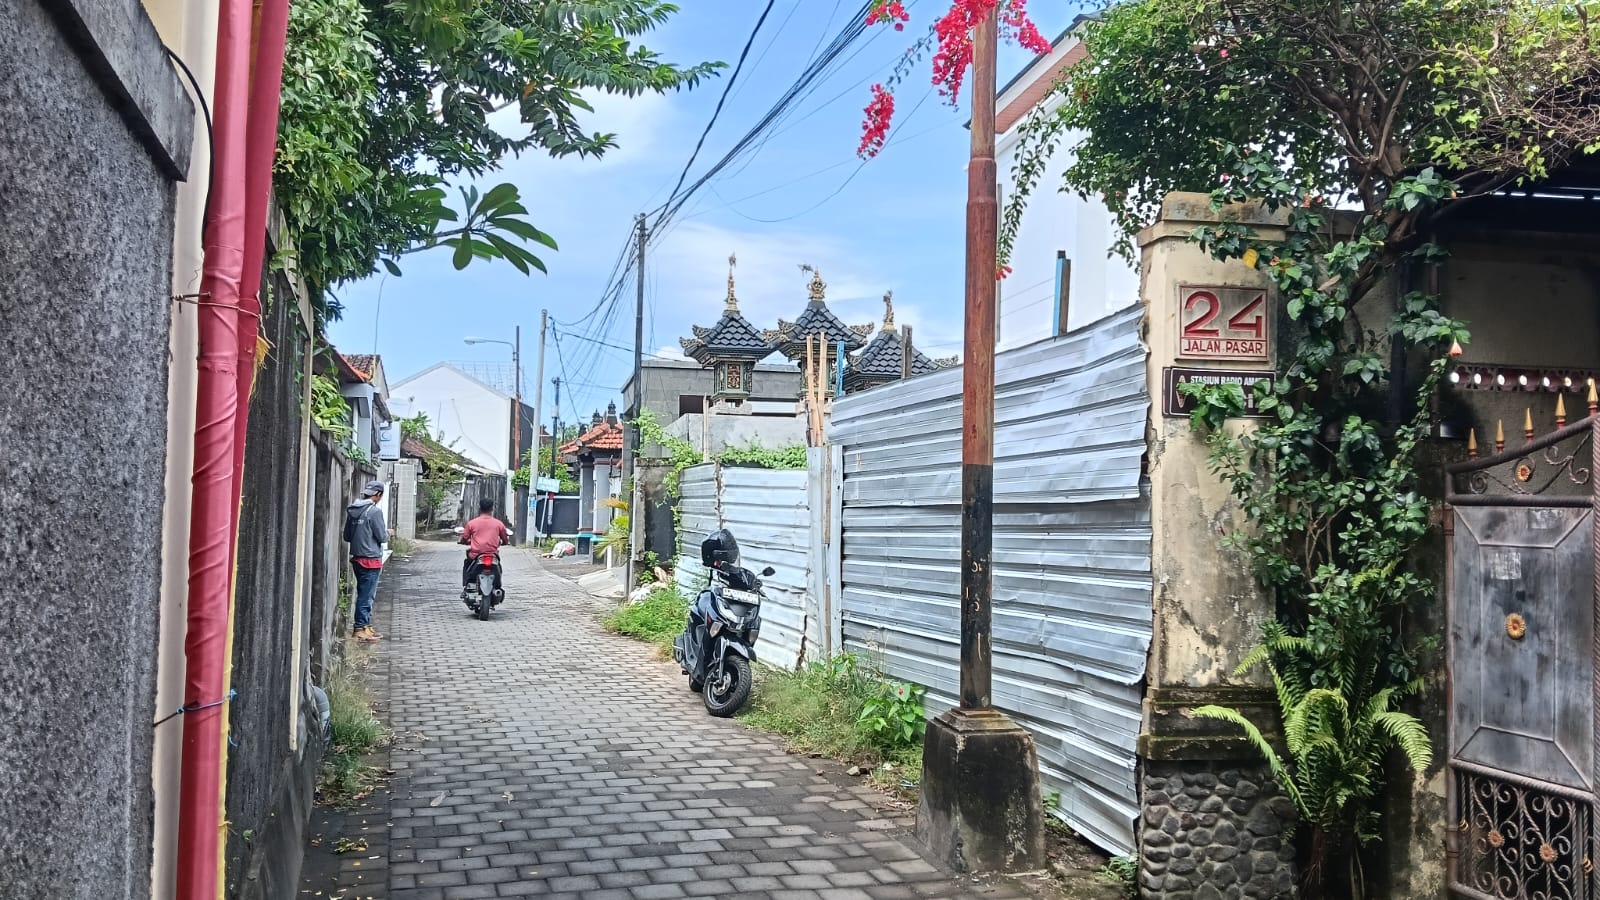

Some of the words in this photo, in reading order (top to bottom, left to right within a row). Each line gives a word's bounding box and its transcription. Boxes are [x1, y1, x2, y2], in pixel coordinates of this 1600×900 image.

[1184, 291, 1263, 338] 24
[1184, 340, 1220, 352] JALAN
[1225, 341, 1263, 354] PASAR
[1190, 375, 1220, 385] STASIUN
[1220, 376, 1243, 385] RADIO
